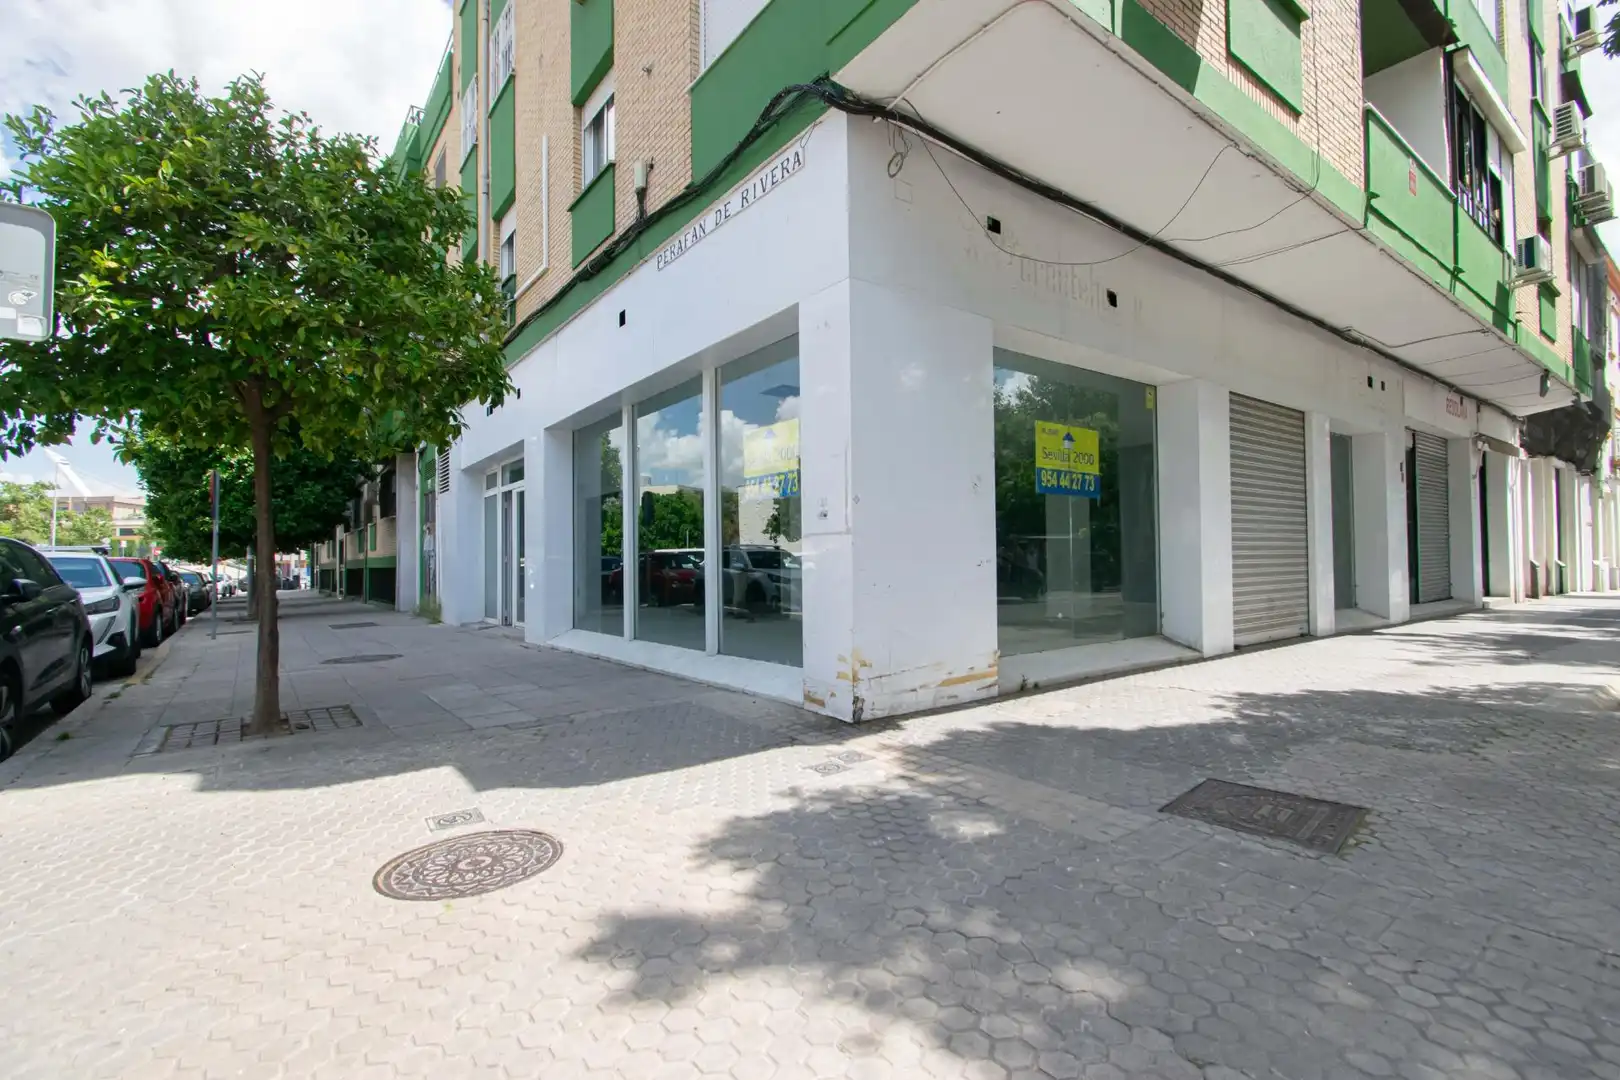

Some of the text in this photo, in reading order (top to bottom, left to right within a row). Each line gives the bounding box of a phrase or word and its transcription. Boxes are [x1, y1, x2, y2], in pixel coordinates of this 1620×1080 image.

[656, 150, 802, 271] PERAFAN DE RIVERA
[1042, 447, 1094, 465] Sevilla 2000
[788, 471, 799, 492] 73
[1041, 469, 1095, 492] 954 44 27 73
